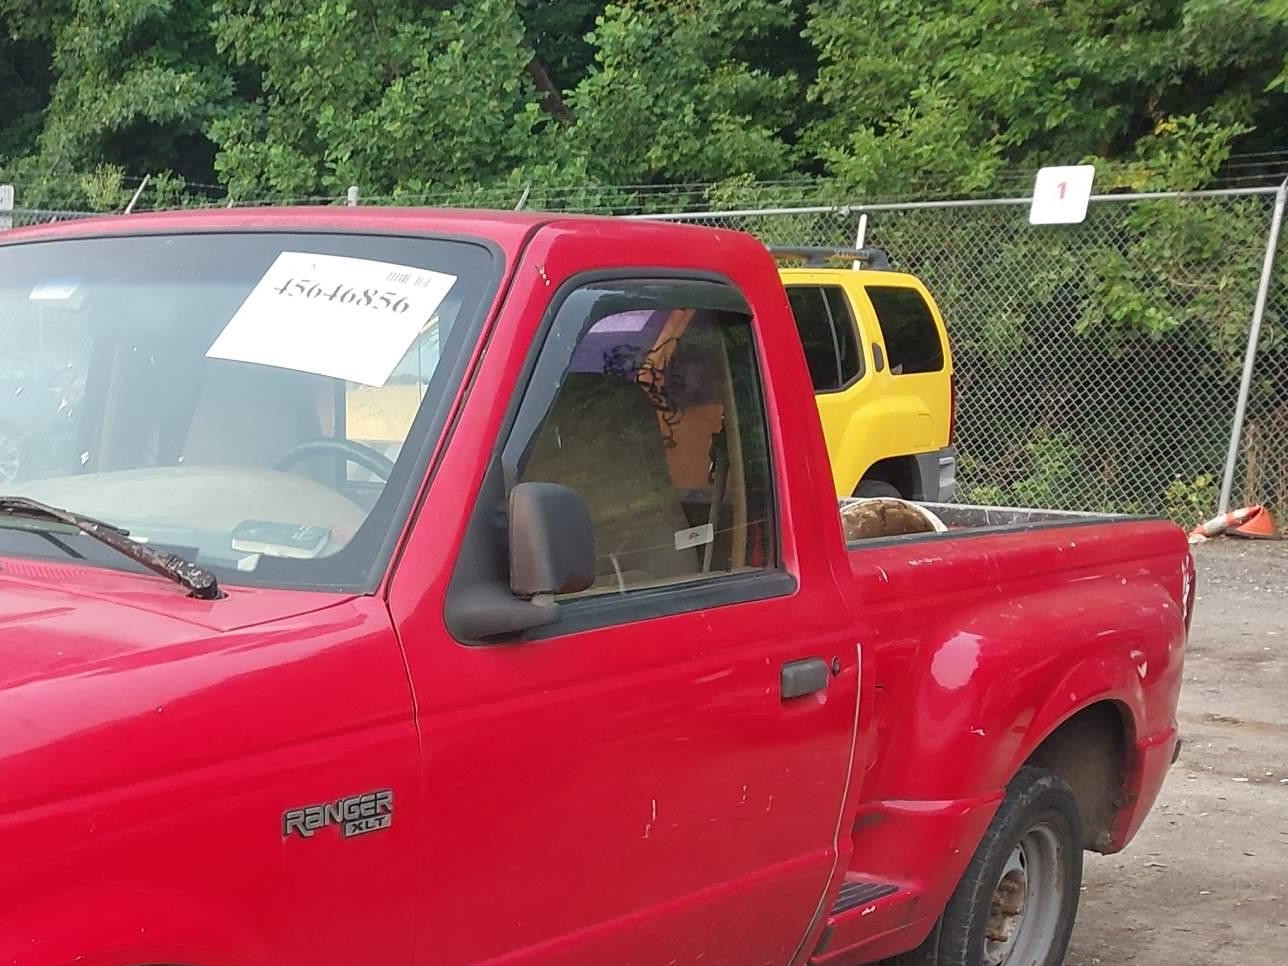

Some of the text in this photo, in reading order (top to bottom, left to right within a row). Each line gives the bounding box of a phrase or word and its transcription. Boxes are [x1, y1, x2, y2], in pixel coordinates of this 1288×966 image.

[1057, 181, 1068, 200] 1
[273, 277, 410, 314] 45646856
[283, 789, 393, 837] RANGER
[350, 815, 388, 834] XLT
